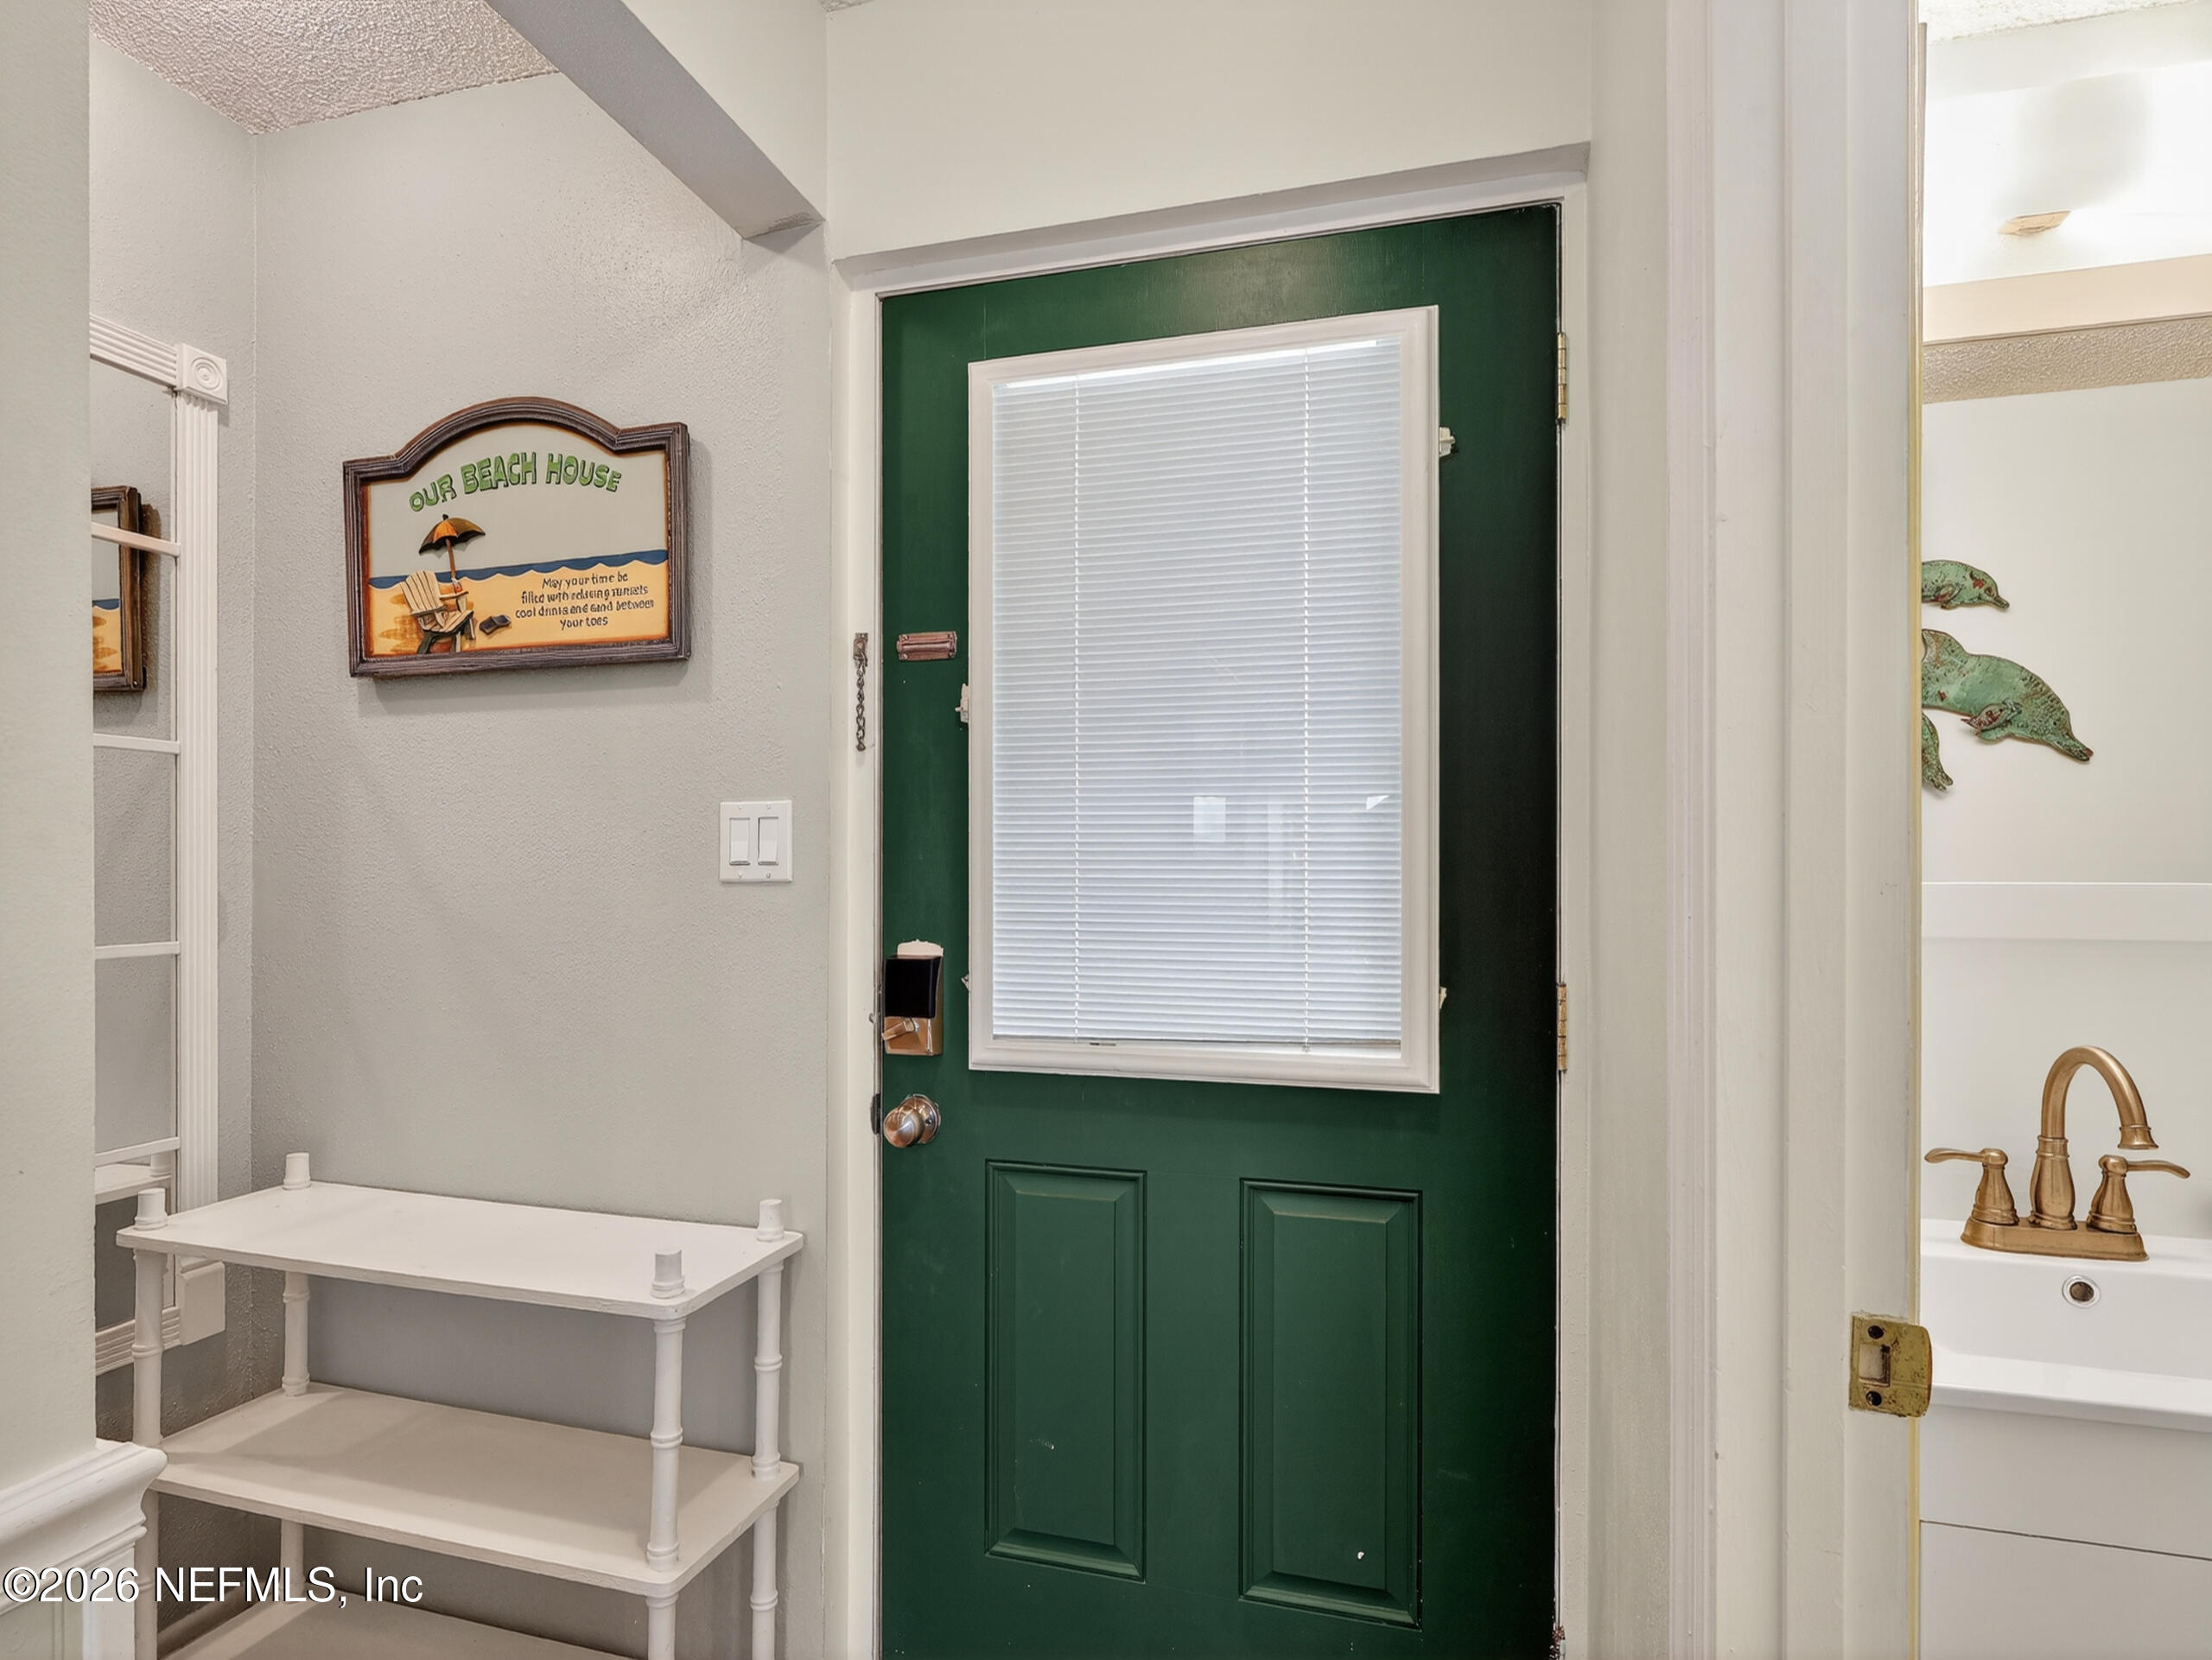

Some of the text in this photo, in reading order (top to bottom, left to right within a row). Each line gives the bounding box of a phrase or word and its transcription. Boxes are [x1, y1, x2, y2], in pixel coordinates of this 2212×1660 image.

[409, 452, 621, 512] OUR BEACH HOUSE
[565, 577, 589, 589] your
[592, 574, 614, 584] time
[618, 571, 628, 582] be
[521, 591, 544, 604] filled
[516, 607, 536, 618] cool
[560, 616, 608, 631] your toes
